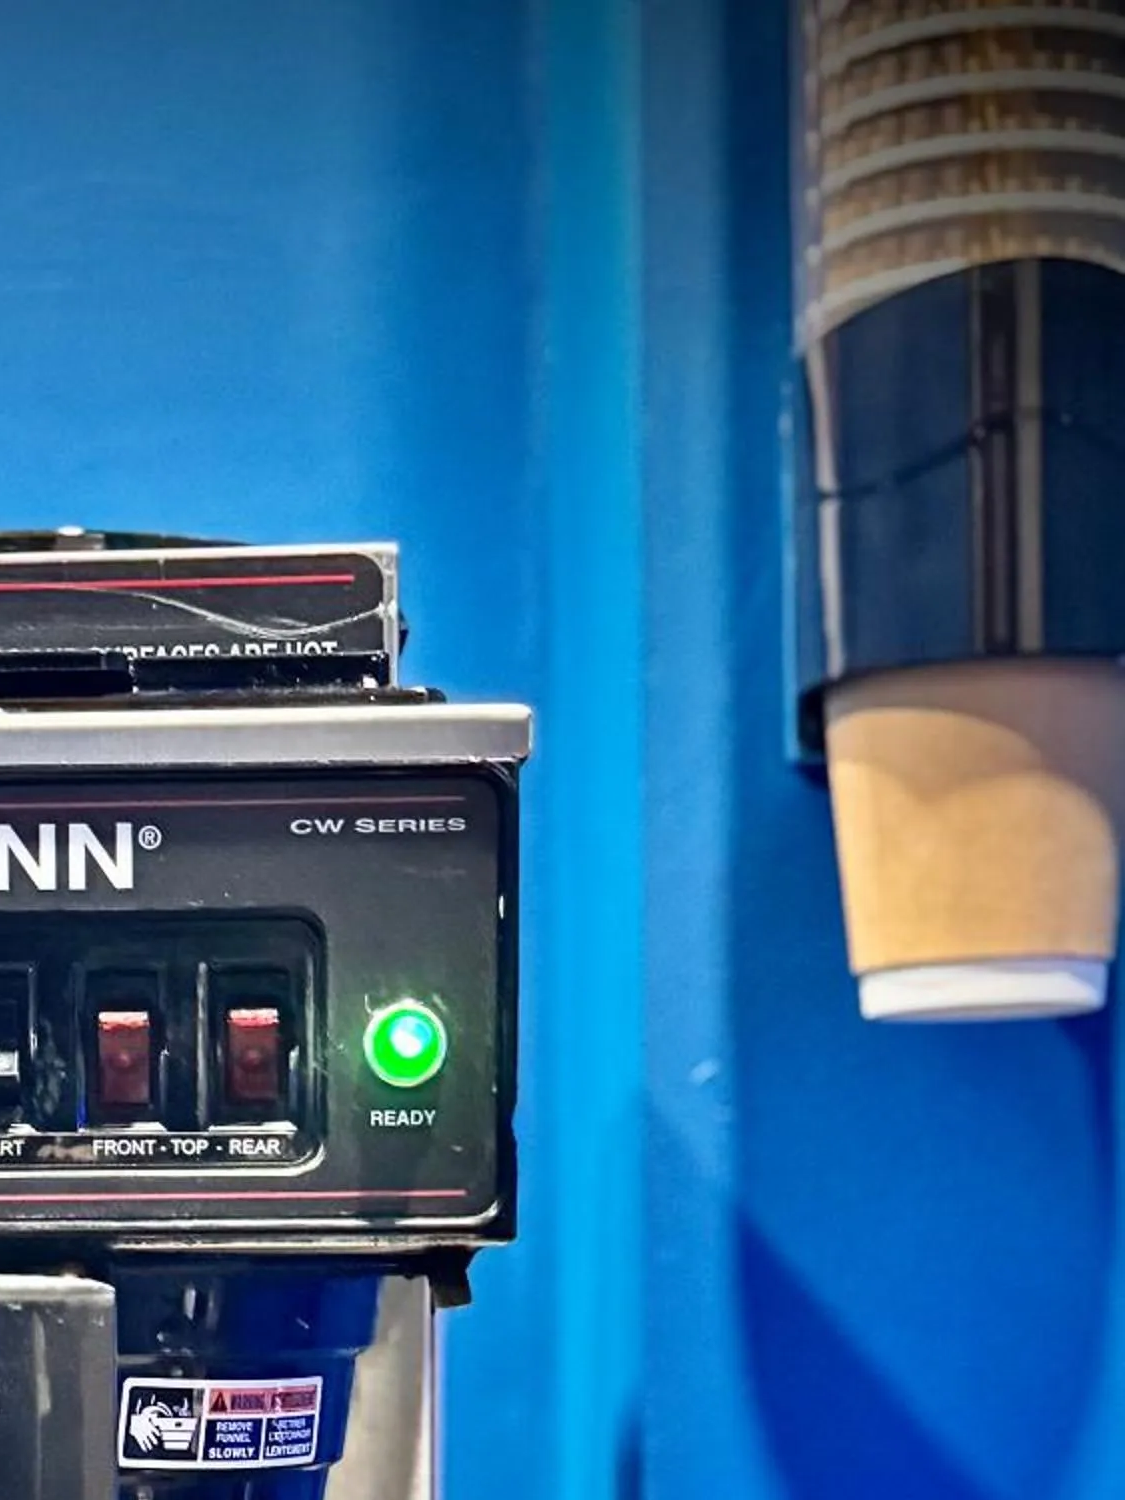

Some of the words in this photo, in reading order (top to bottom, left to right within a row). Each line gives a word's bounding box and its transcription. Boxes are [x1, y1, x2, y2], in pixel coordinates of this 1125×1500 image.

[290, 819, 345, 835] CW
[355, 817, 466, 833] SERIES
[371, 1109, 435, 1127] READY
[92, 1139, 156, 1155] FRONT
[171, 1139, 208, 1155] TOP
[229, 1139, 280, 1155] REAR
[209, 1447, 255, 1459] SLOWLY
